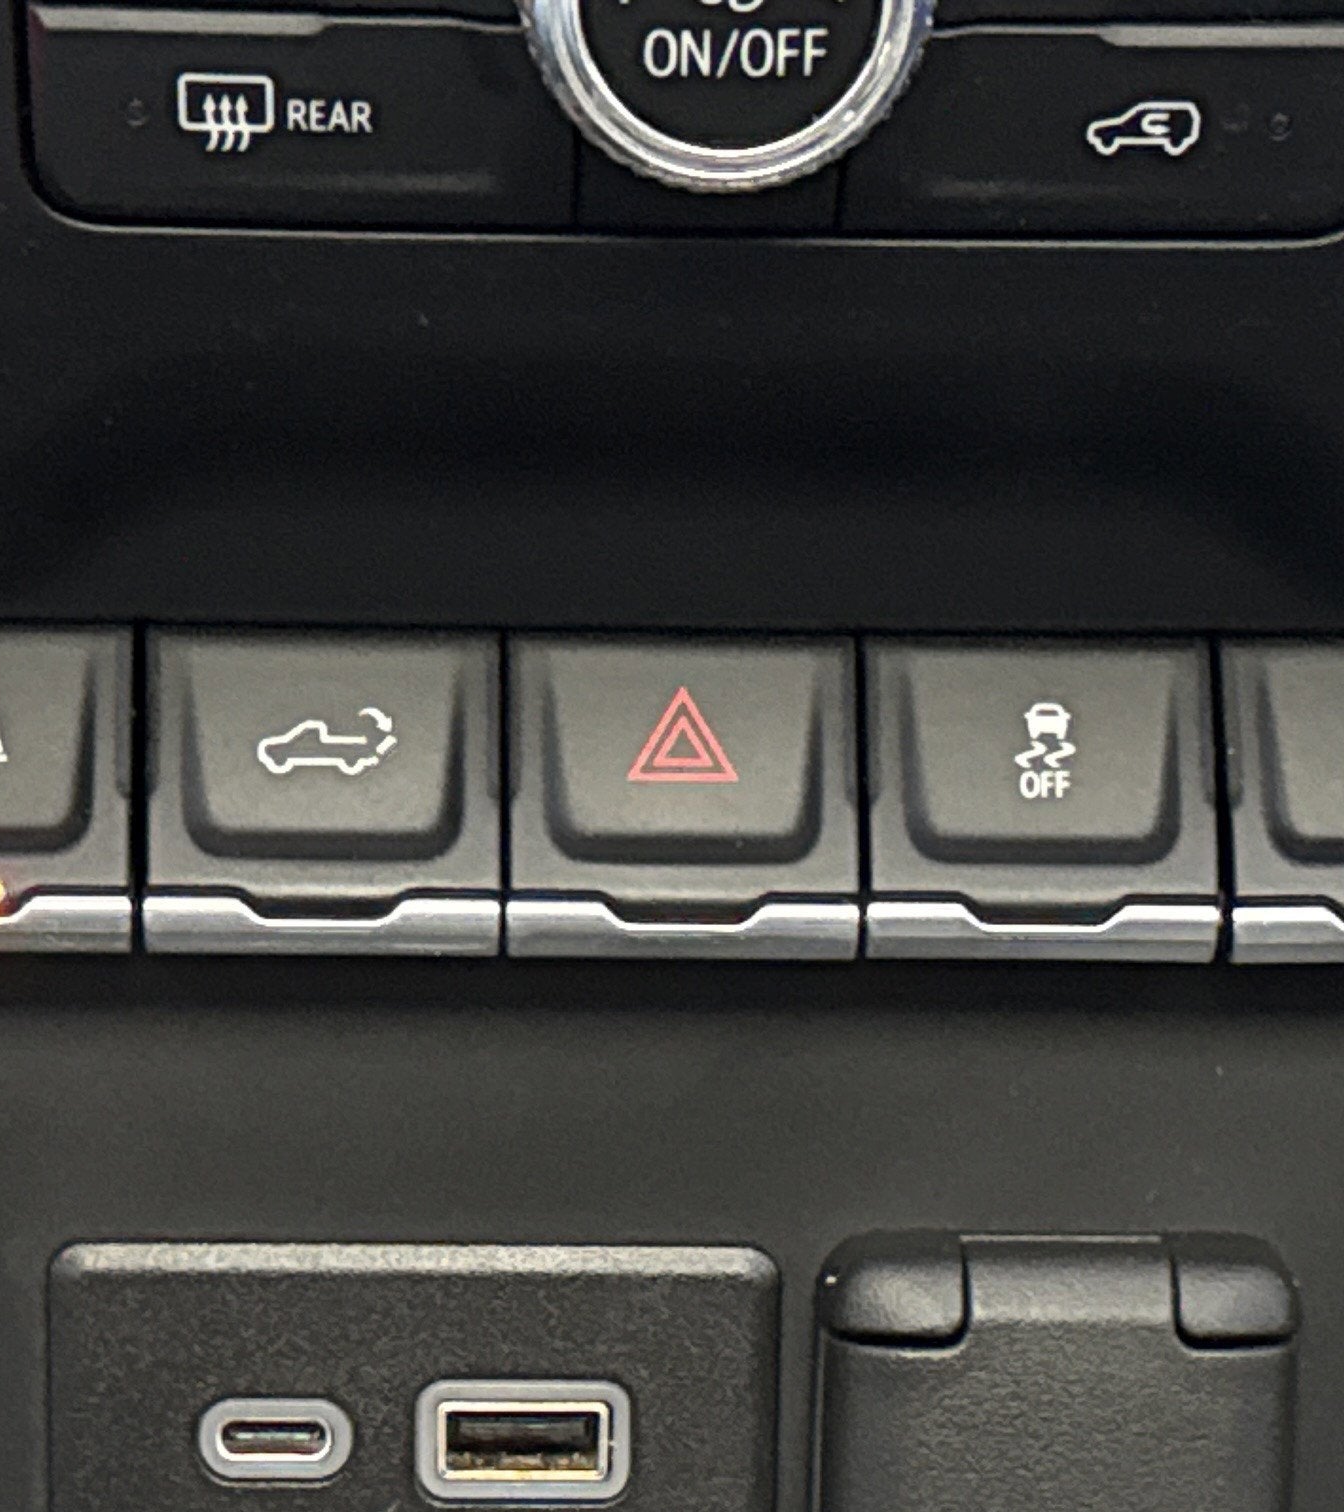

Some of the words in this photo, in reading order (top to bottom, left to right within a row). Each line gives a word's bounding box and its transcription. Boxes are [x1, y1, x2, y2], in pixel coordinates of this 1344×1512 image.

[642, 27, 829, 79] ON/OFF
[286, 98, 373, 134] REAR
[1019, 769, 1071, 799] OFF
